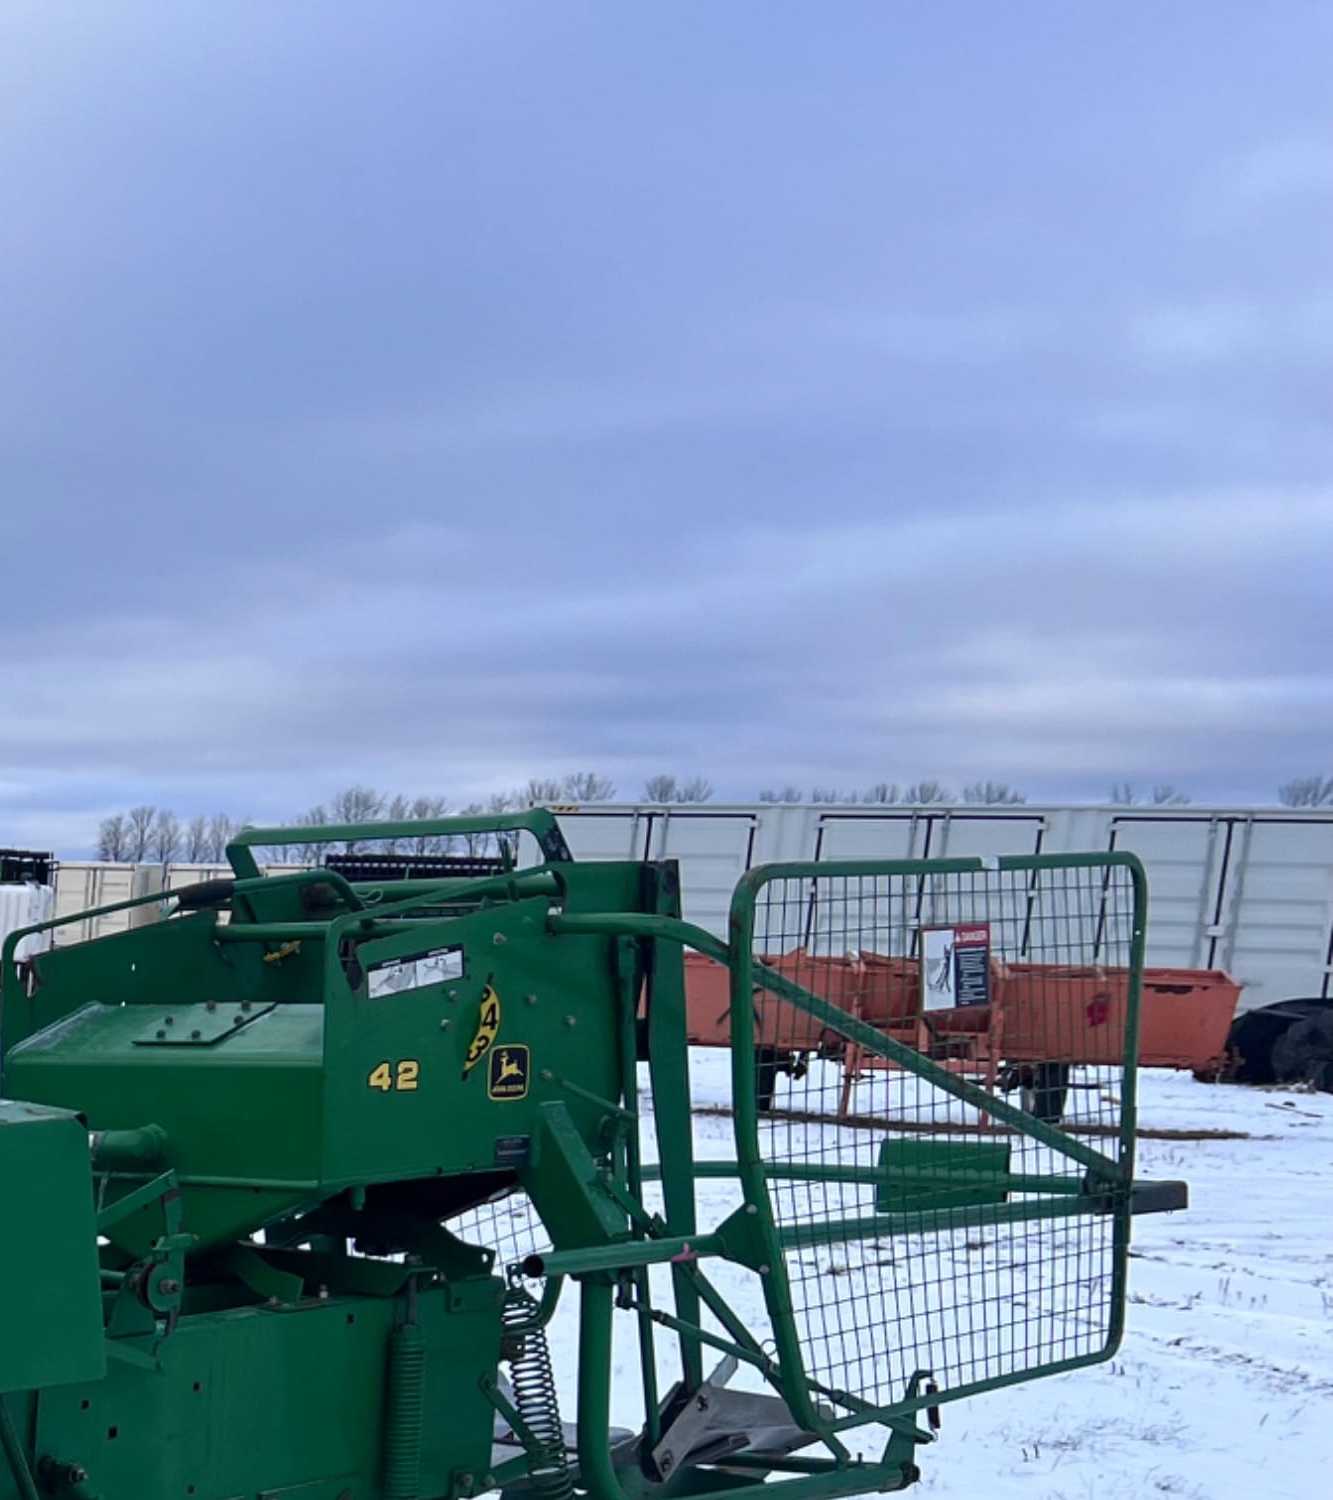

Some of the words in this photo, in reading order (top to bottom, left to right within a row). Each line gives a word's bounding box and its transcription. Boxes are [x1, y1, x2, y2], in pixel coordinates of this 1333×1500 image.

[481, 1002, 499, 1031] 4
[466, 1034, 491, 1063] 3
[368, 1060, 419, 1092] 42
